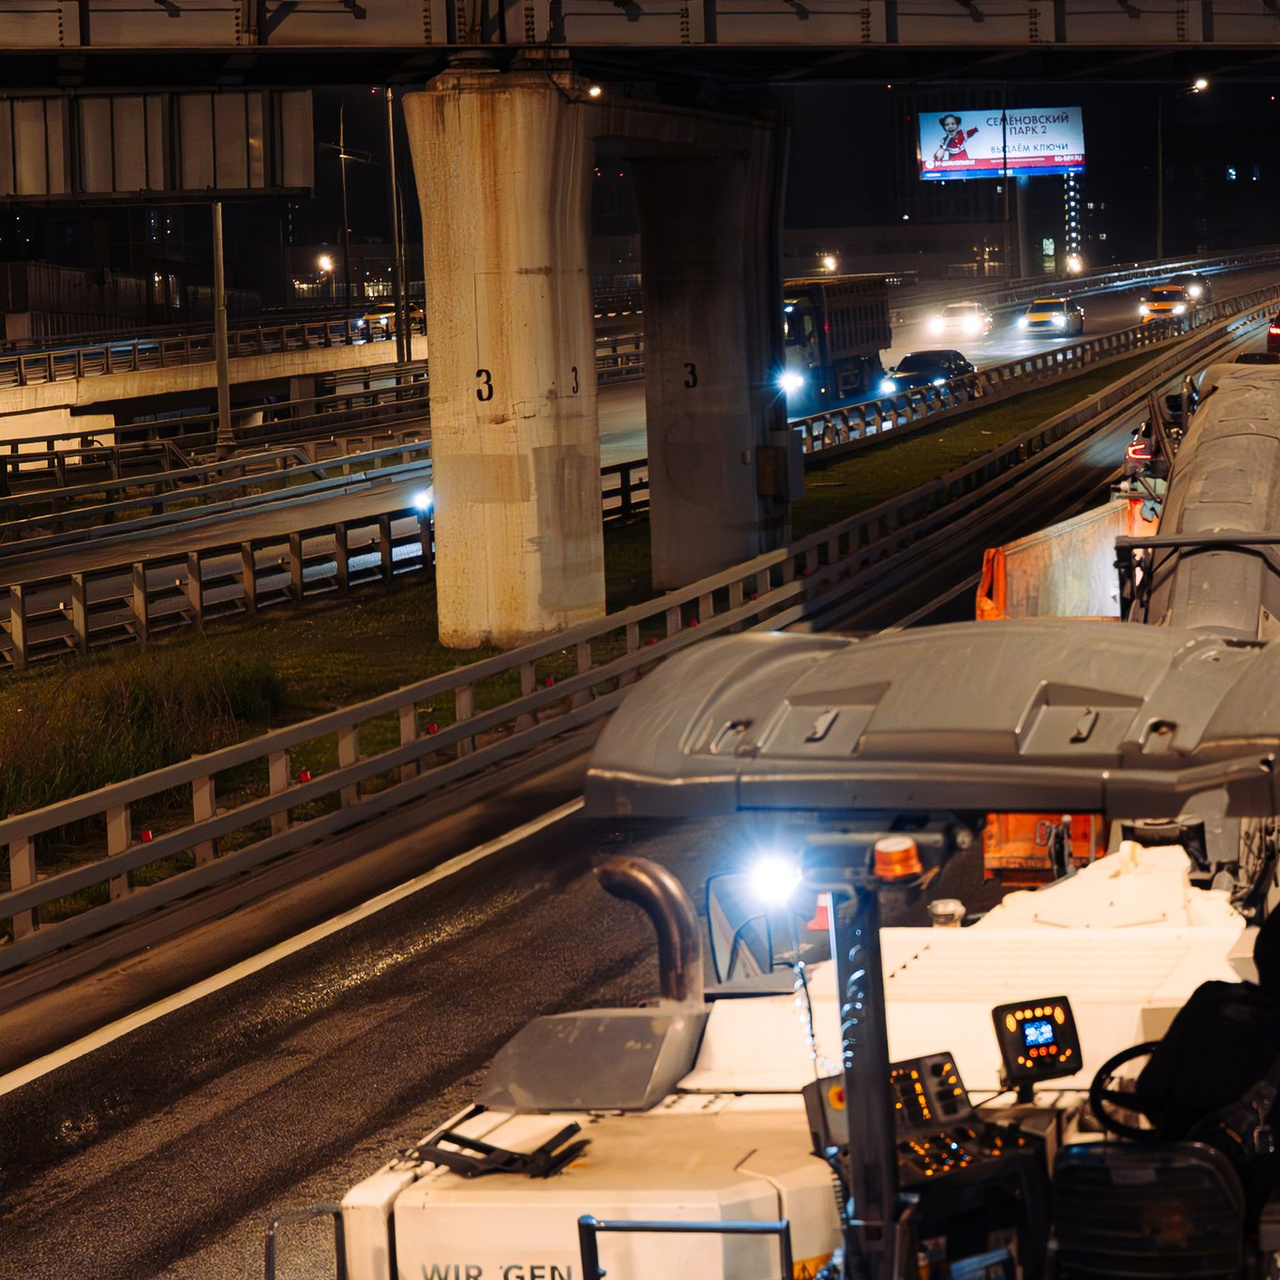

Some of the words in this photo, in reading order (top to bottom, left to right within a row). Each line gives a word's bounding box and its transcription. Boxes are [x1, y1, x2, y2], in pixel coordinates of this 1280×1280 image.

[986, 112, 1069, 127] СЕМЁНОВСКИЙ
[1010, 126, 1038, 135] ПАРК
[1042, 125, 1047, 134] 2
[991, 144, 1030, 154] ВЫДАЁМ
[1034, 143, 1069, 152] КЛЮЧИ
[476, 369, 493, 401] 3
[571, 366, 579, 394] 3
[684, 363, 697, 388] 3
